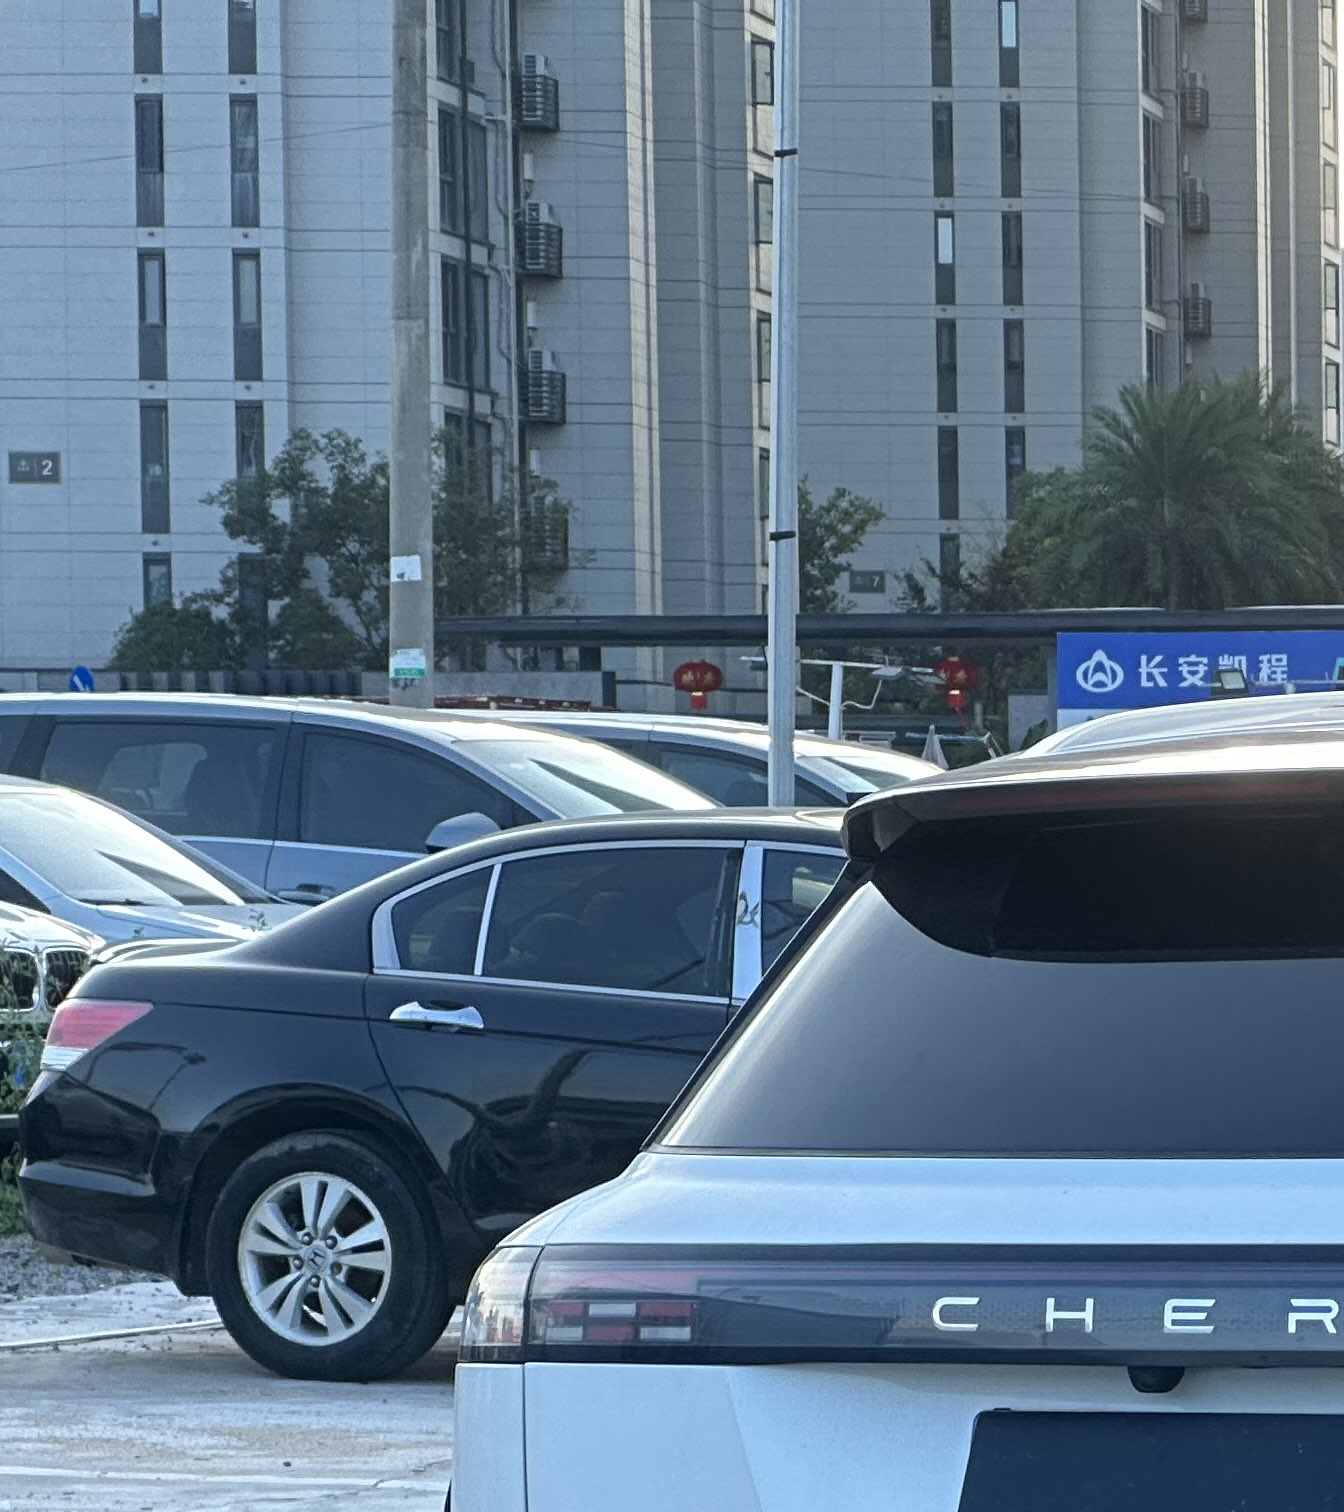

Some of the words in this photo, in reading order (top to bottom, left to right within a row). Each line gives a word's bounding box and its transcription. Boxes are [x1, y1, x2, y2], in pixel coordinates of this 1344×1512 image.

[41, 459, 53, 476] 2
[1139, 653, 1288, 688] 长安凯程
